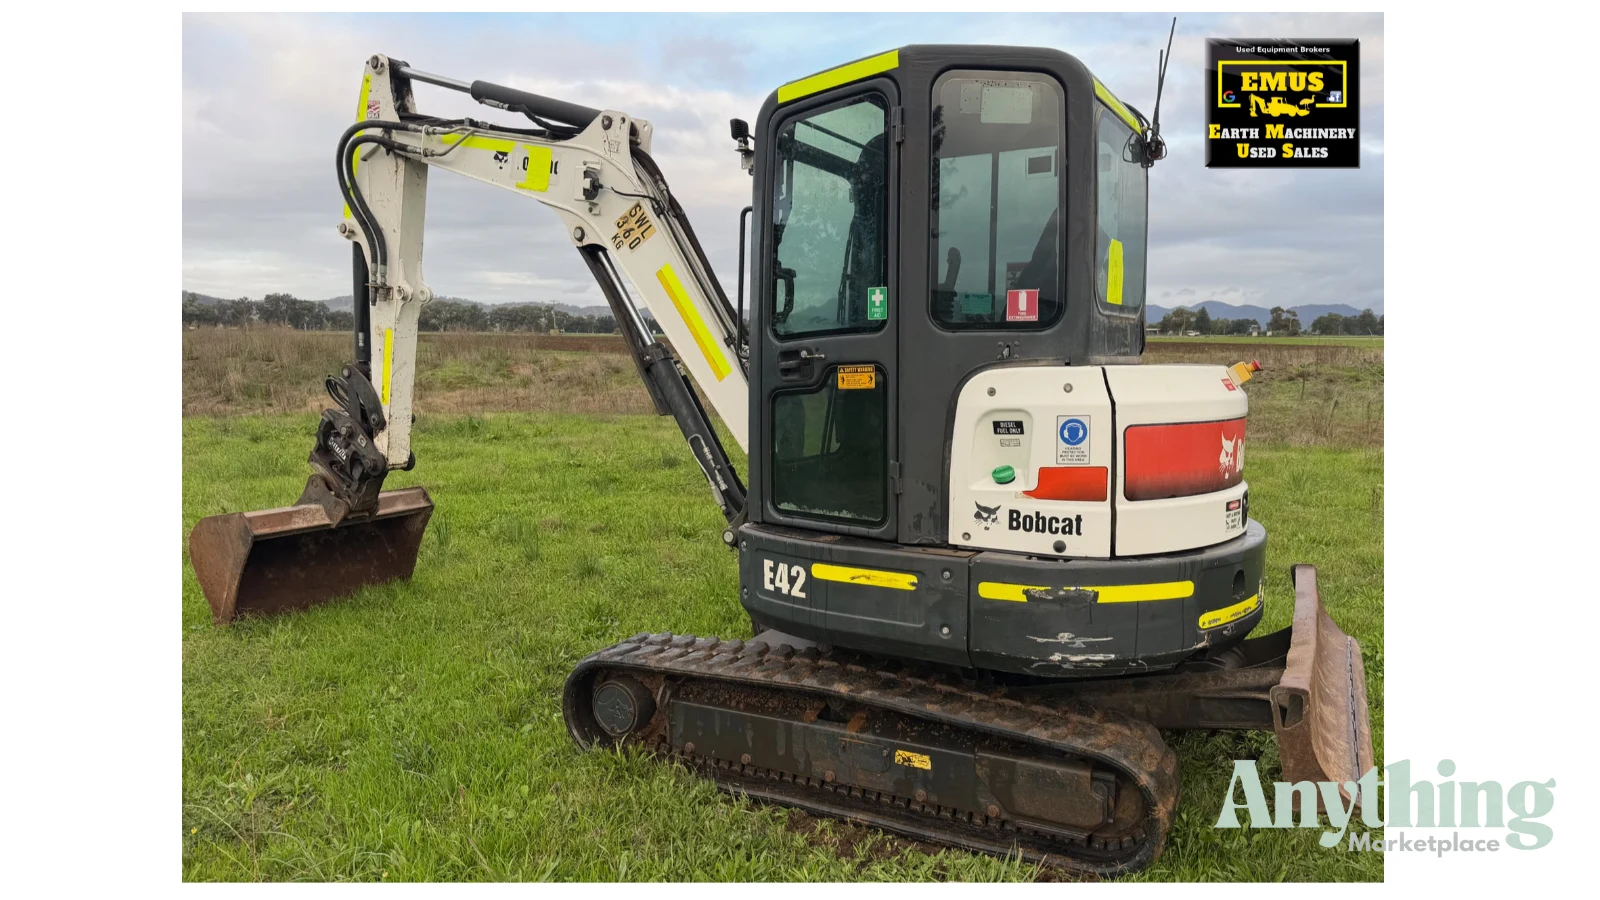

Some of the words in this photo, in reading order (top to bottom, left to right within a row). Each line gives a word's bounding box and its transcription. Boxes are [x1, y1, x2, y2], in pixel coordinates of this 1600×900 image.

[616, 215, 642, 250] 360
[629, 202, 653, 240] SWL
[611, 232, 625, 250] KG
[1008, 508, 1082, 536] Bobcat
[763, 558, 807, 599] E42
